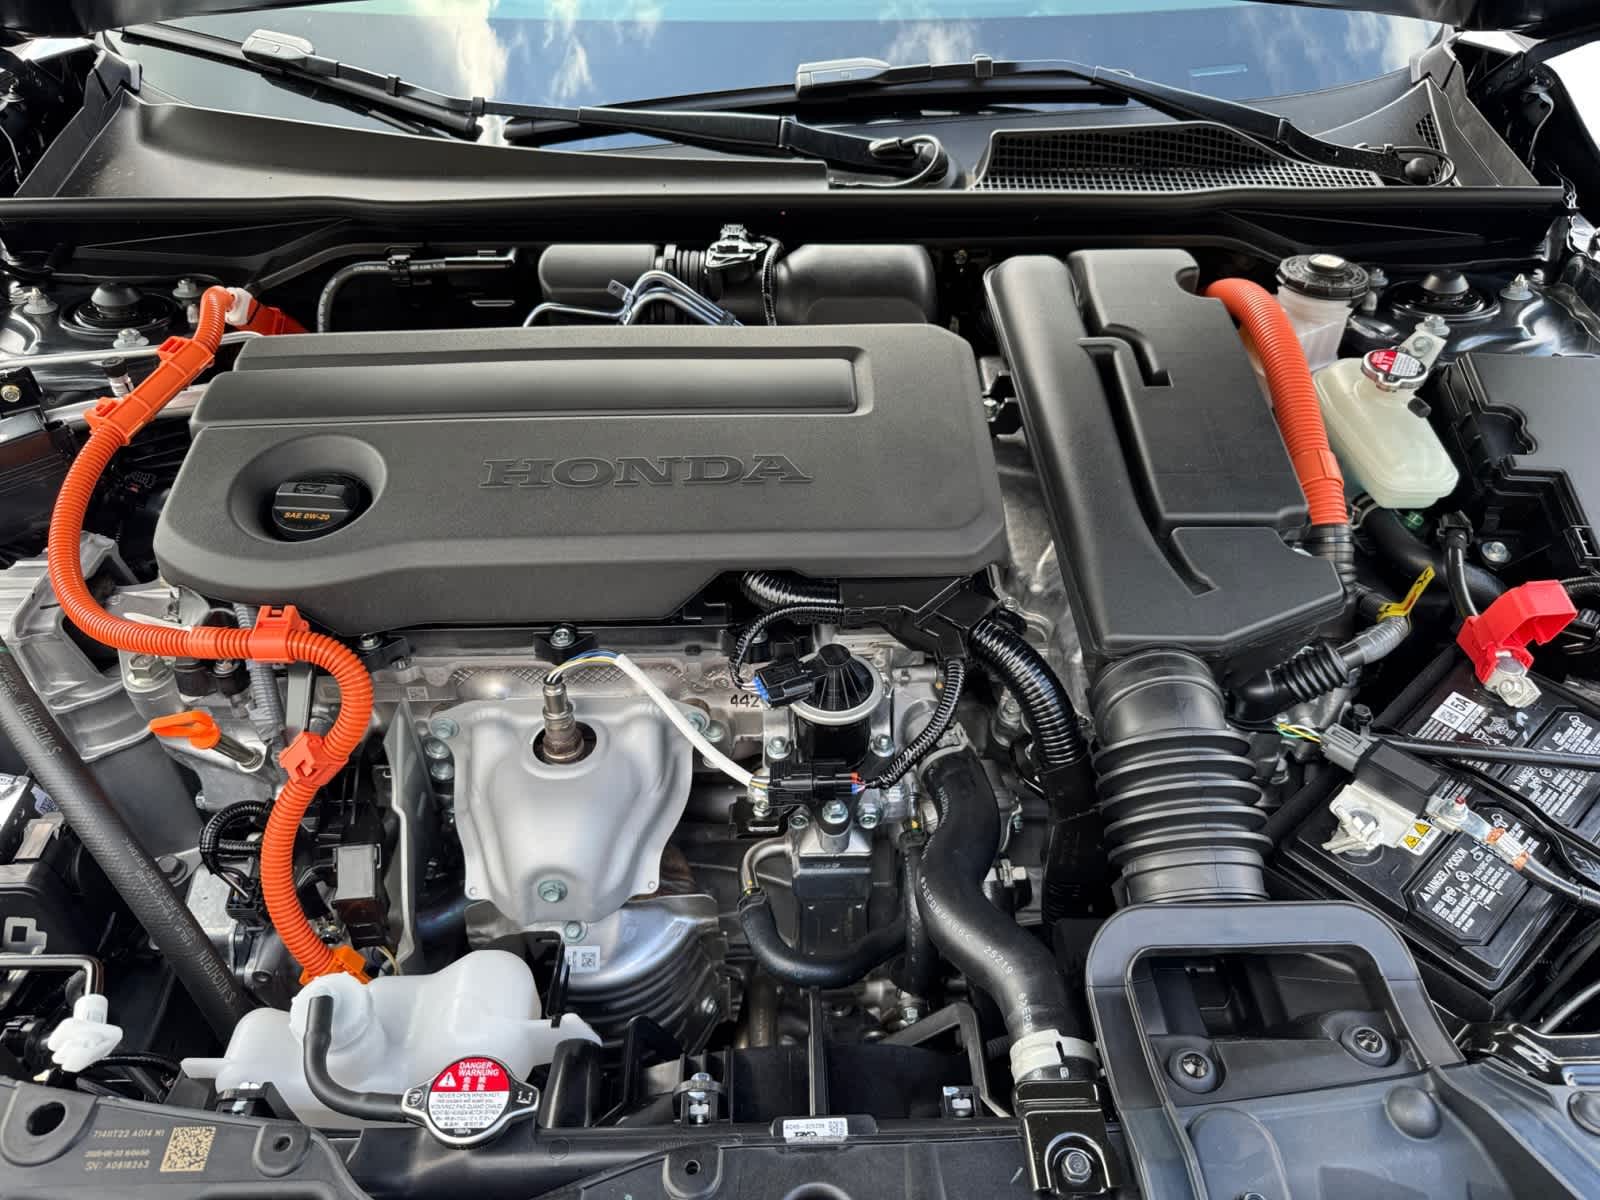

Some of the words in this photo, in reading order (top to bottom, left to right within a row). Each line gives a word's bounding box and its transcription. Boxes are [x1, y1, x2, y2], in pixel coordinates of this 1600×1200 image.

[479, 455, 814, 488] HONDA
[283, 511, 302, 519] SAE
[1450, 697, 1472, 712] 5A
[1425, 868, 1449, 896] DANGER
[459, 1061, 493, 1069] DANGER
